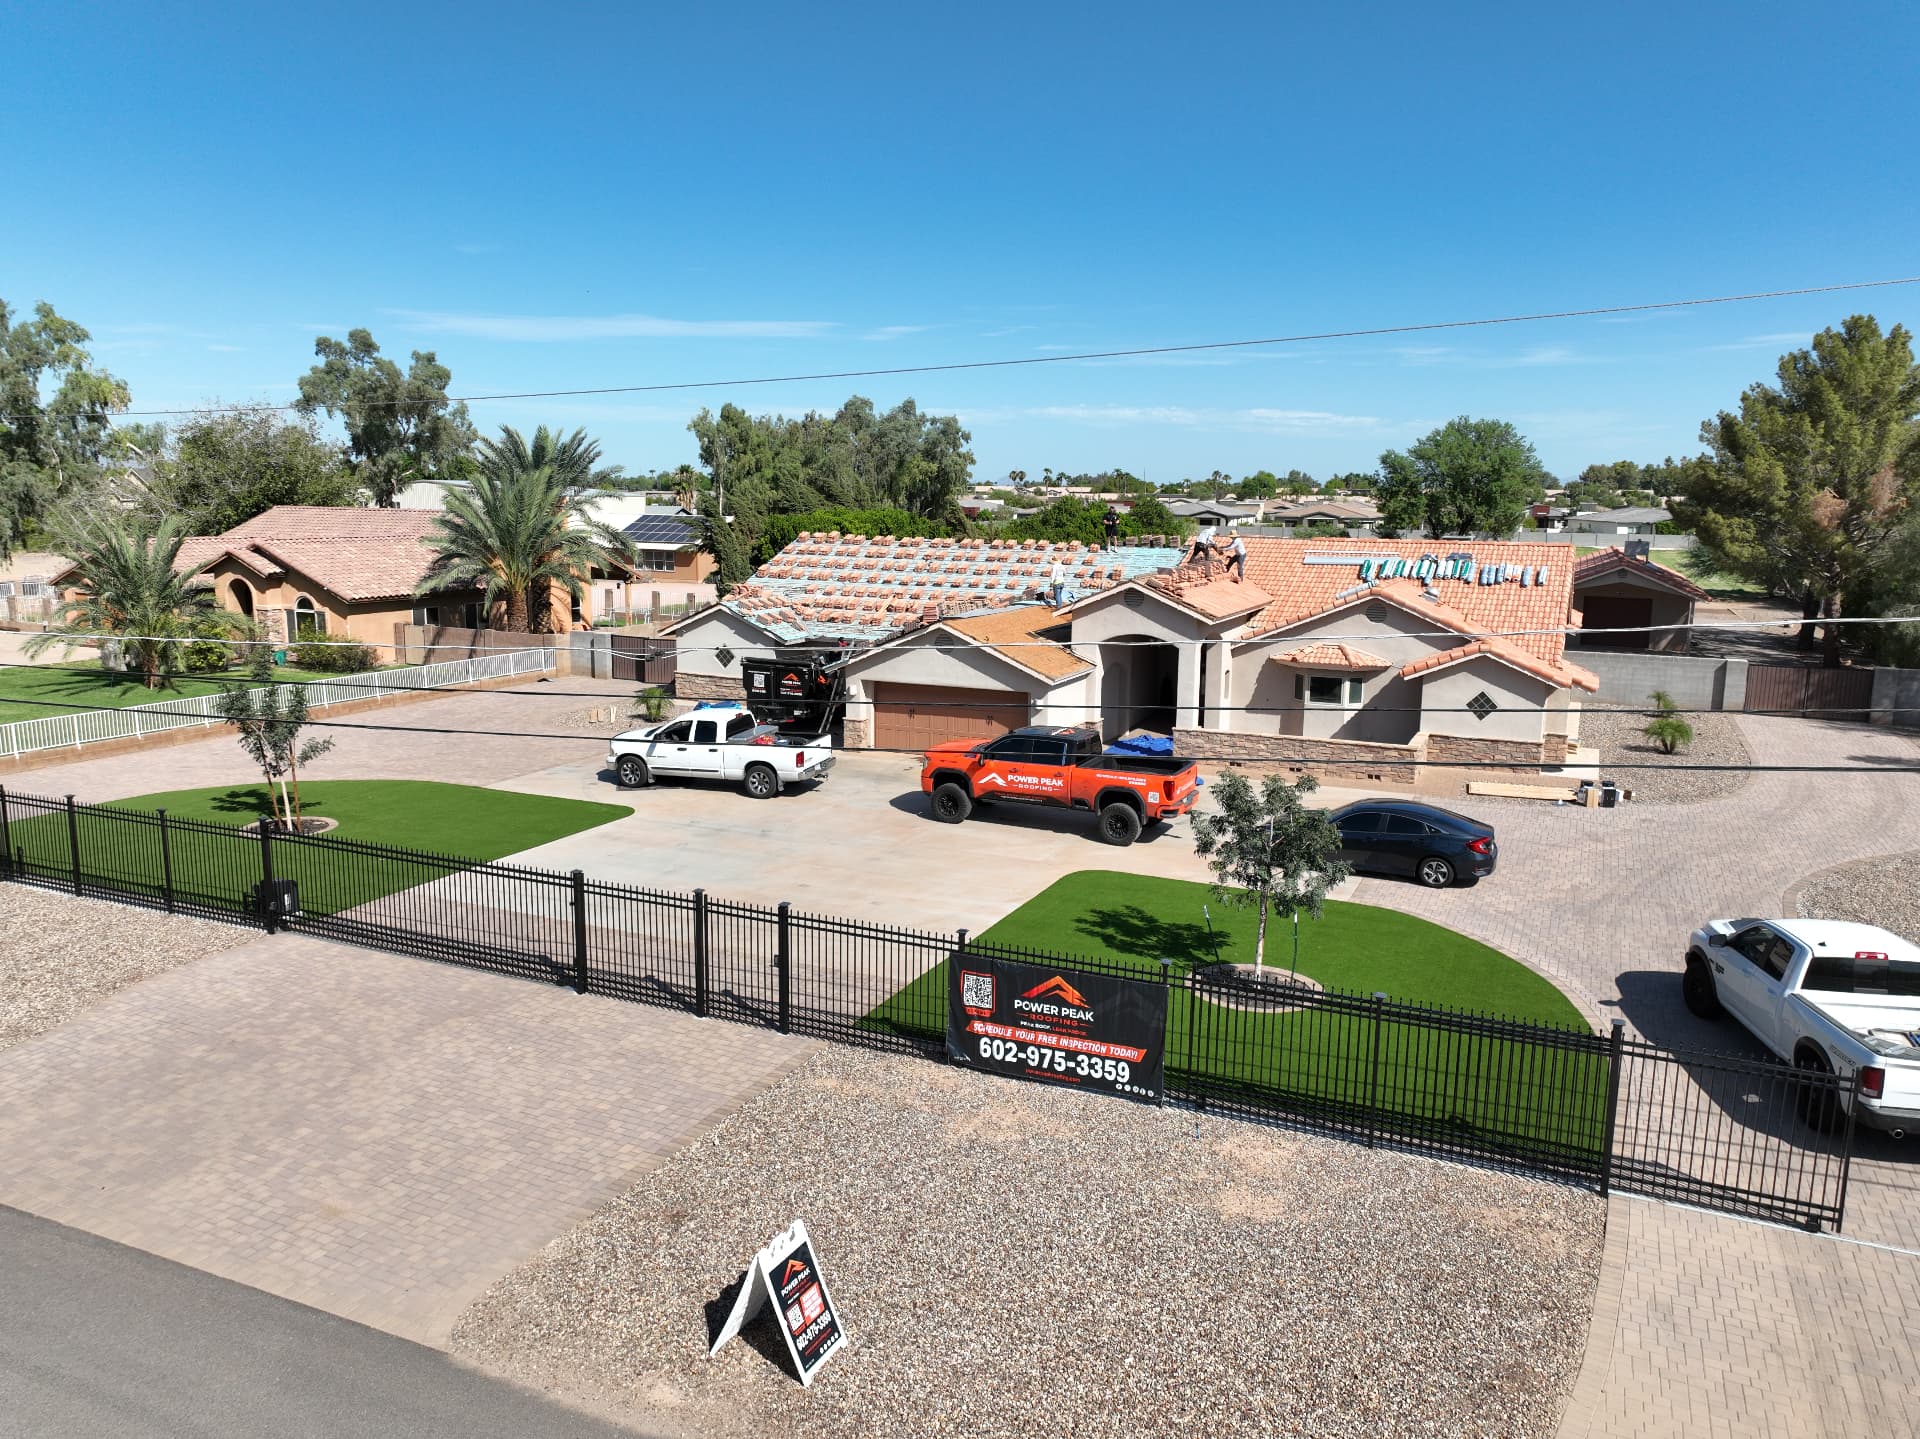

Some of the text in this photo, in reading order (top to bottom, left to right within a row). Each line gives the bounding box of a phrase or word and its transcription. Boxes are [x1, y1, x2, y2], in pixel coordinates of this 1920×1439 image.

[1007, 774, 1064, 787] POWER PEAK
[1018, 783, 1053, 791] ROOFING
[1014, 999, 1095, 1022] POWER PEAK
[1029, 1013, 1079, 1027] ROOFING
[973, 1023, 1138, 1060] SCHEDULE YOUR FREE INSPECTION TODAY!
[979, 1036, 1130, 1083] 602-975-3359
[781, 1277, 799, 1298] POWER
